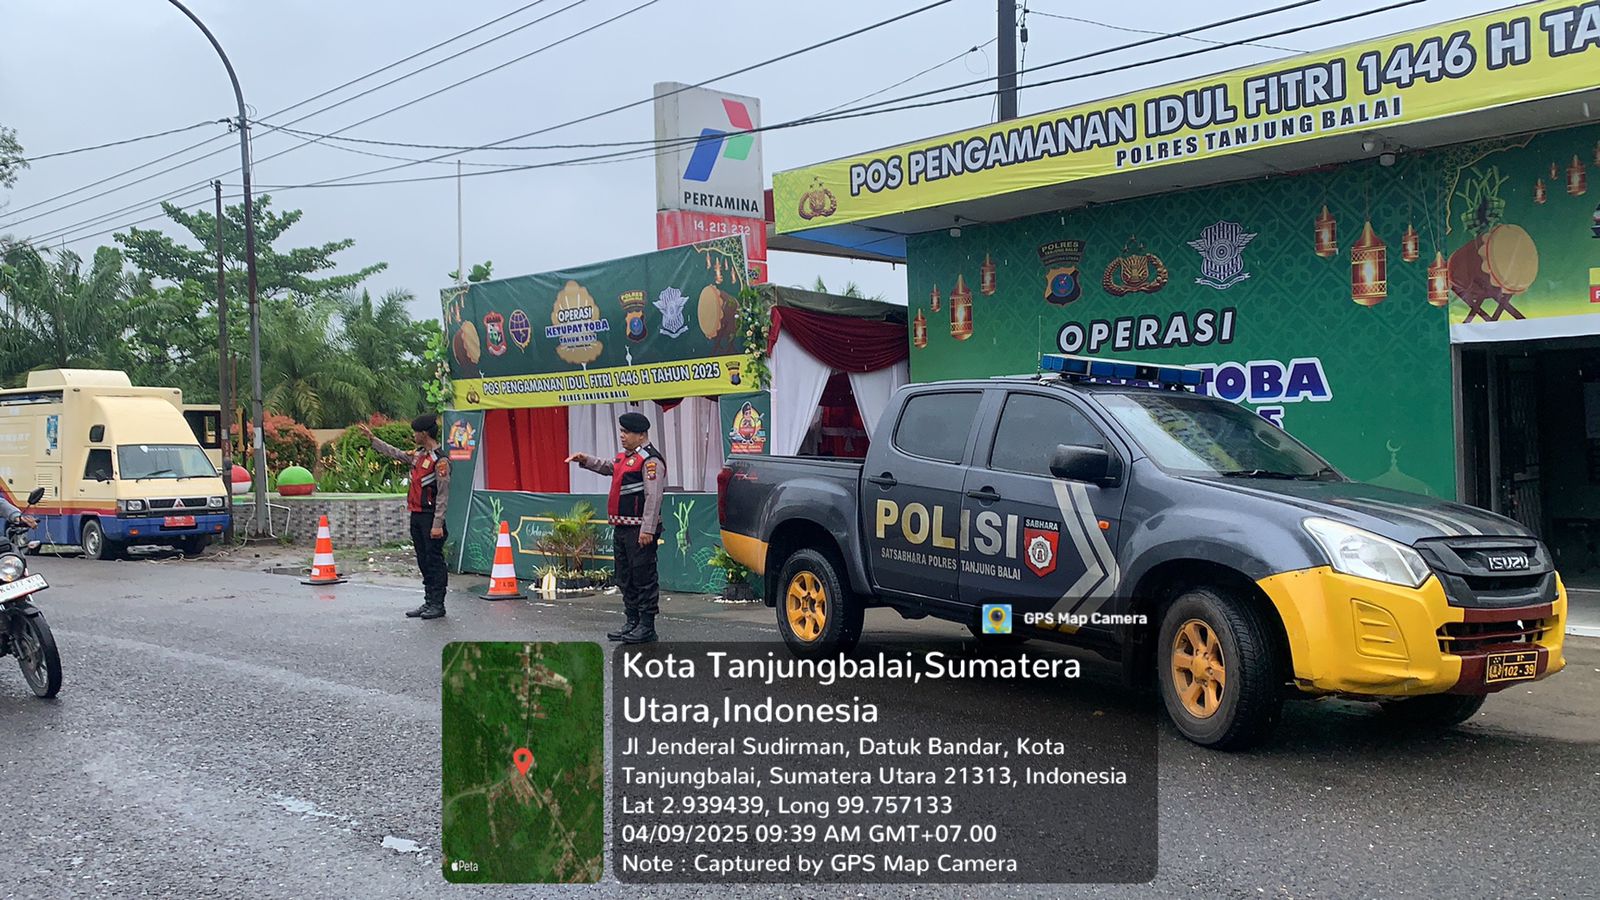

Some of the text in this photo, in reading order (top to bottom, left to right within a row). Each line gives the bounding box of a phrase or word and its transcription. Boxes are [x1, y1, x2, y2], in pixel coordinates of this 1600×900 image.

[850, 156, 902, 196] POS
[908, 105, 1136, 184] PENGAMANAN
[1146, 85, 1236, 136] IDUL
[1244, 60, 1345, 118] FITRI
[1359, 33, 1474, 93] 1446
[1488, 18, 1529, 69] H
[1116, 97, 1401, 167] POLRES TANJUNG BALAI
[684, 191, 759, 213] PERTAMINA
[694, 220, 751, 236] 14.213.232
[1041, 241, 1079, 253] POLRES
[558, 306, 592, 323] OPERASI
[545, 320, 609, 338] KETUPAT TOBA
[1057, 309, 1236, 354] OPERASI
[482, 362, 720, 395] POS PENGAMANAN IDUL FITRI 1446 H TAHUN 2025
[559, 390, 629, 402] POLRES TANJUNG BALAI
[875, 498, 1019, 559] POLISI
[1025, 518, 1059, 532] SABHARA
[881, 547, 1021, 581] SATSABHARA POLRES TANJUNG BALAI
[1489, 555, 1529, 570] ISUZU
